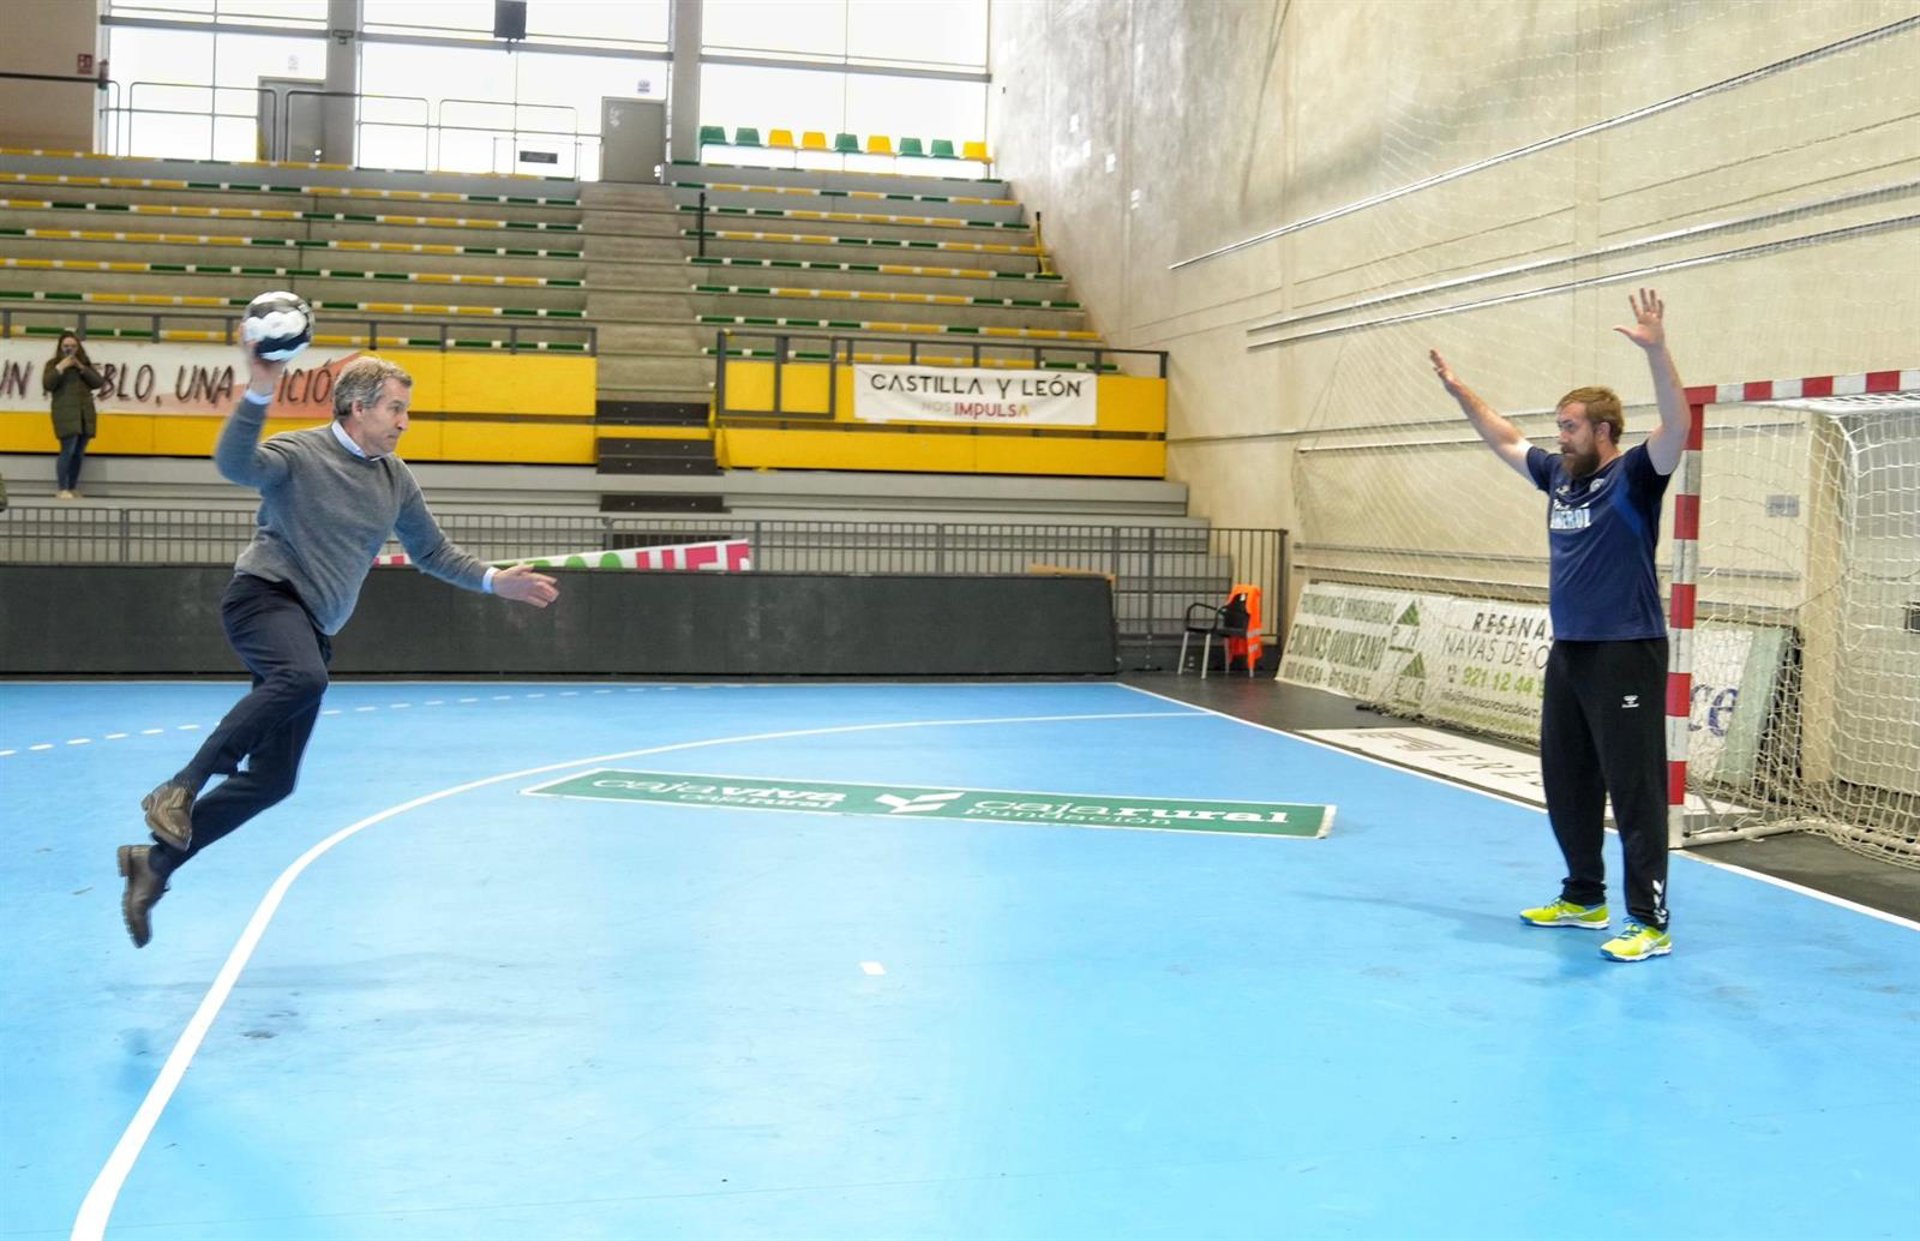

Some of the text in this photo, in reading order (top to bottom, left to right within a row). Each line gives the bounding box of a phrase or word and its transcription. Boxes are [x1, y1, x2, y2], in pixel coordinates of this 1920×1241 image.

[175, 365, 235, 407] UNA
[870, 373, 1082, 399] CASTILLA Y LEÓN
[954, 402, 1030, 418] IMPULSA
[1472, 612, 1555, 642] RESINA
[1442, 631, 1498, 662] NAVAS
[1502, 641, 1529, 667] DE
[1463, 666, 1489, 688] 921
[1492, 671, 1512, 692] 12
[963, 808, 1172, 825] Fundación
